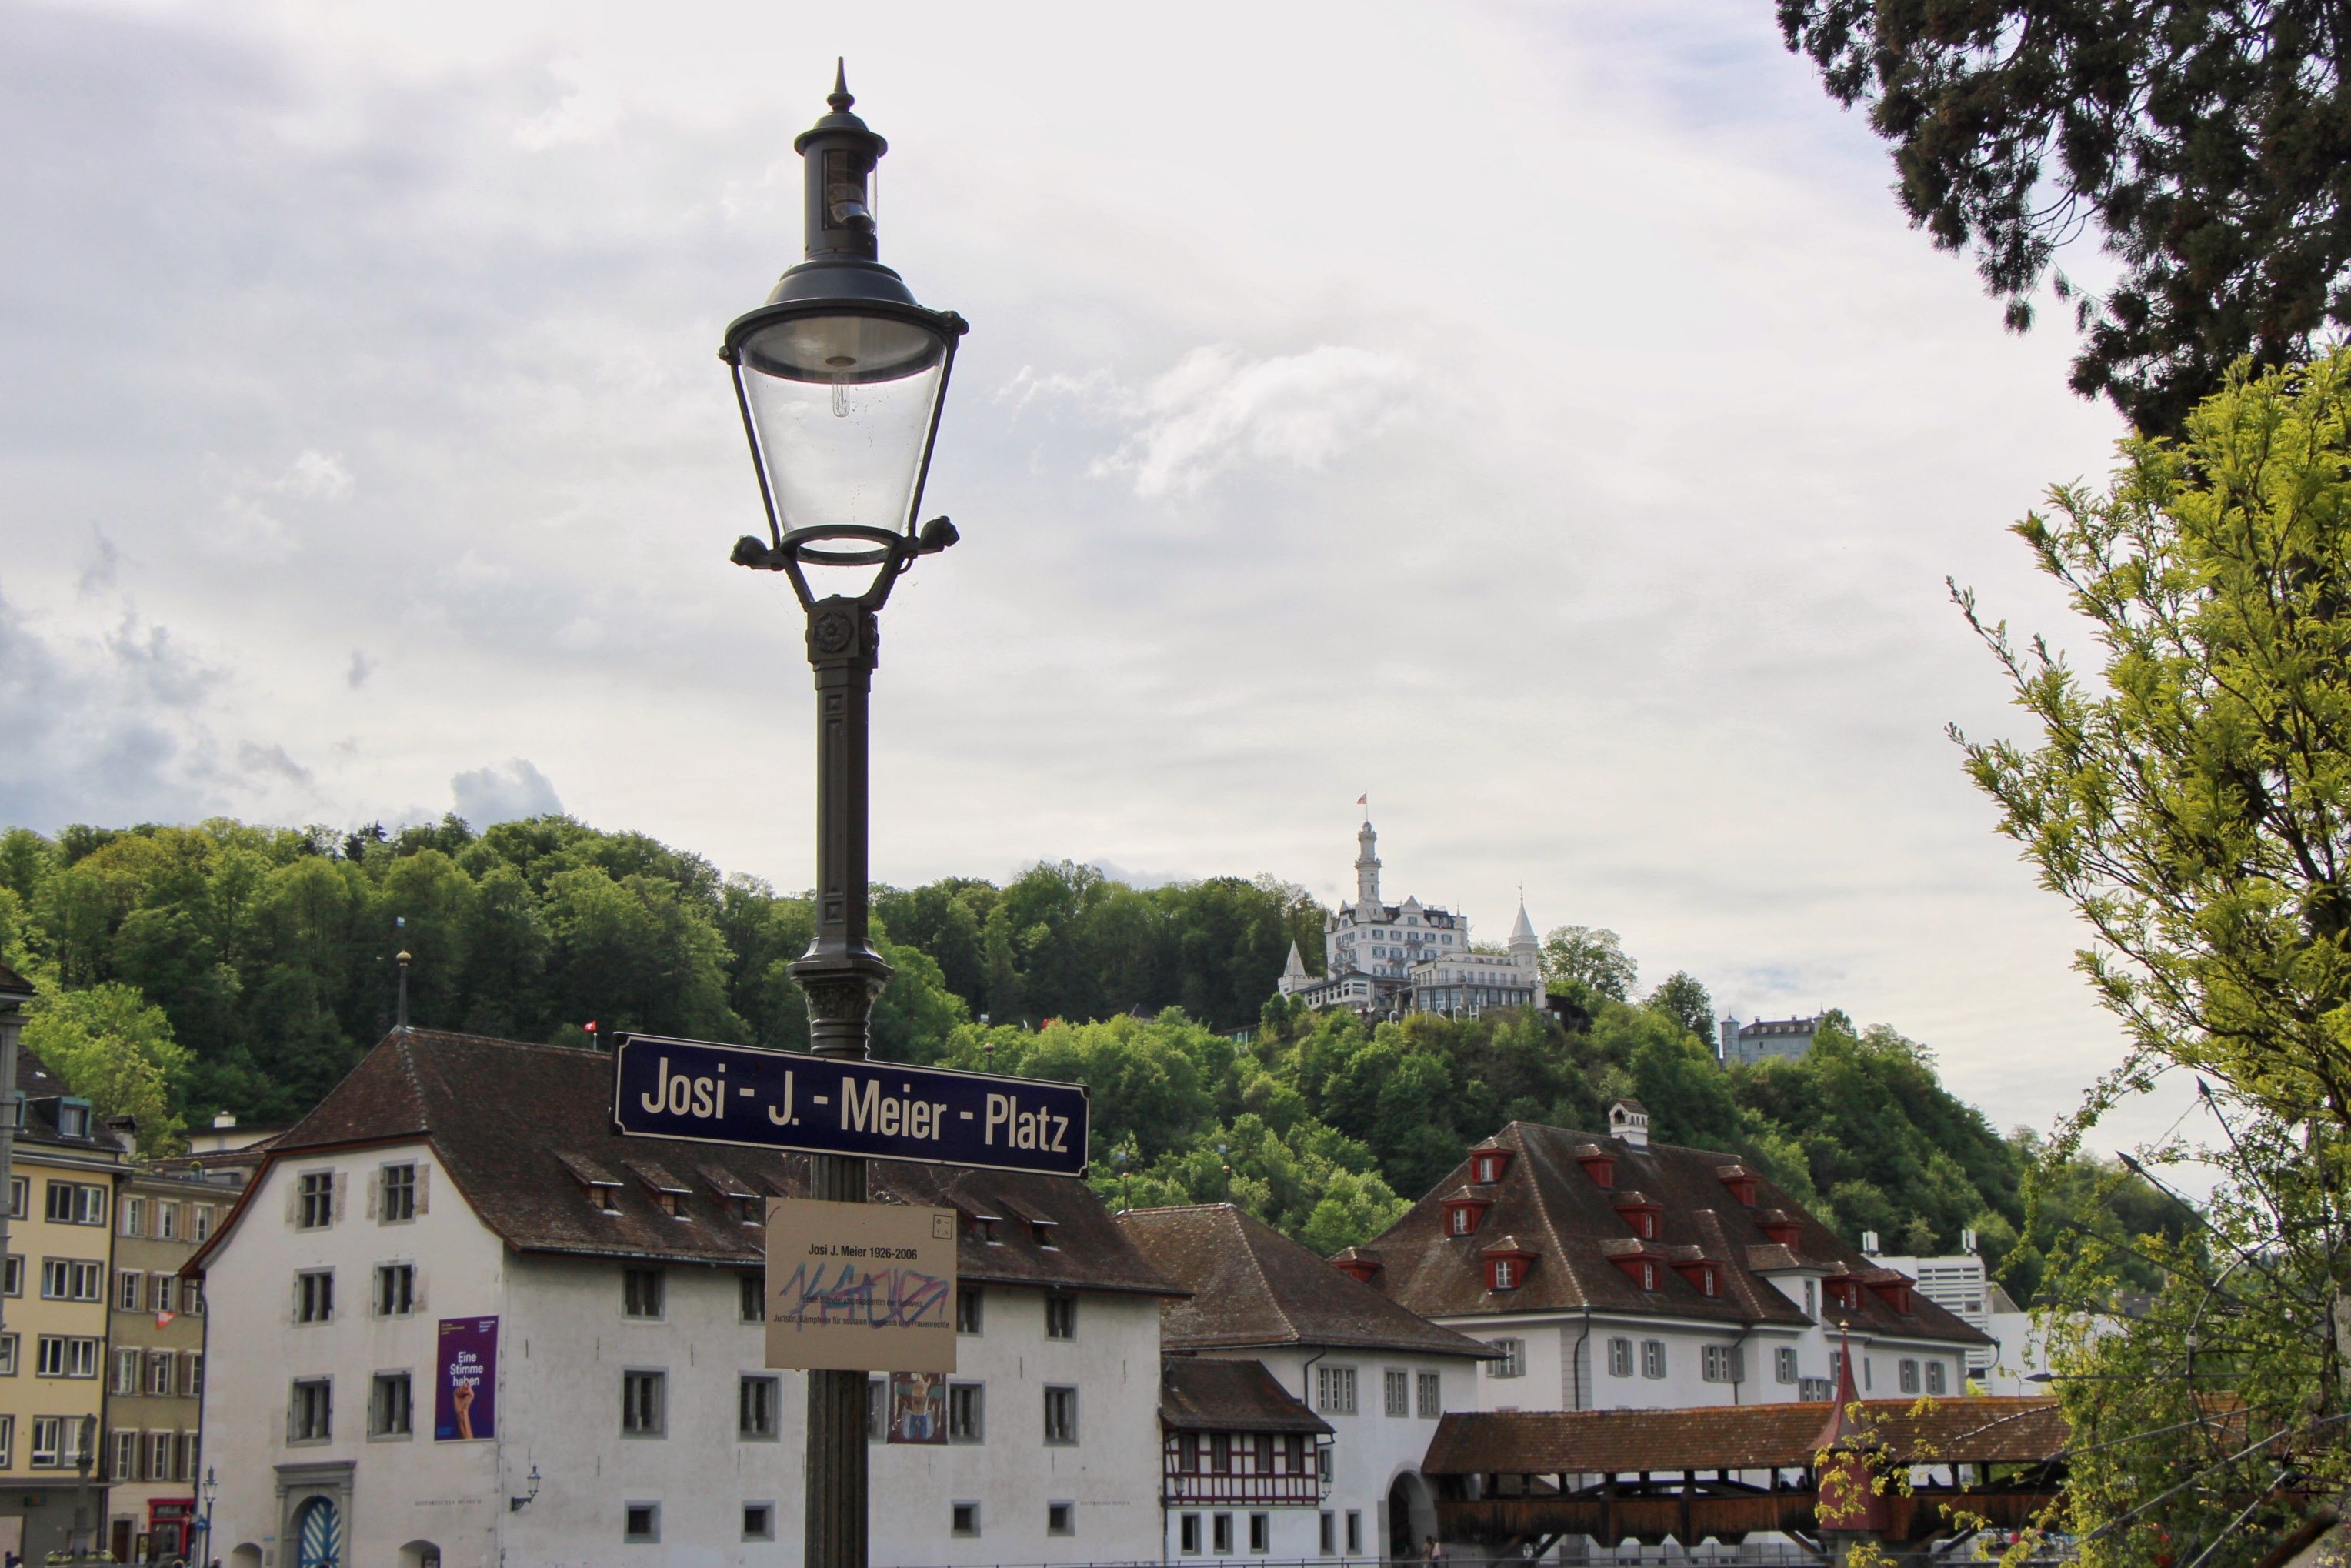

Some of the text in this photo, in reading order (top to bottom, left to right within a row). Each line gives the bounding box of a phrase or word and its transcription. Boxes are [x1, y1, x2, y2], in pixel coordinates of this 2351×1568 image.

[808, 1243, 918, 1260] Josi J. Meier 1926-2006
[832, 1316, 842, 1324] für
[842, 1316, 868, 1326] sozialen
[911, 1320, 950, 1329] Frauenrechte
[458, 1351, 477, 1363] Eine
[450, 1363, 484, 1375] Stimme
[452, 1375, 480, 1387] haben
